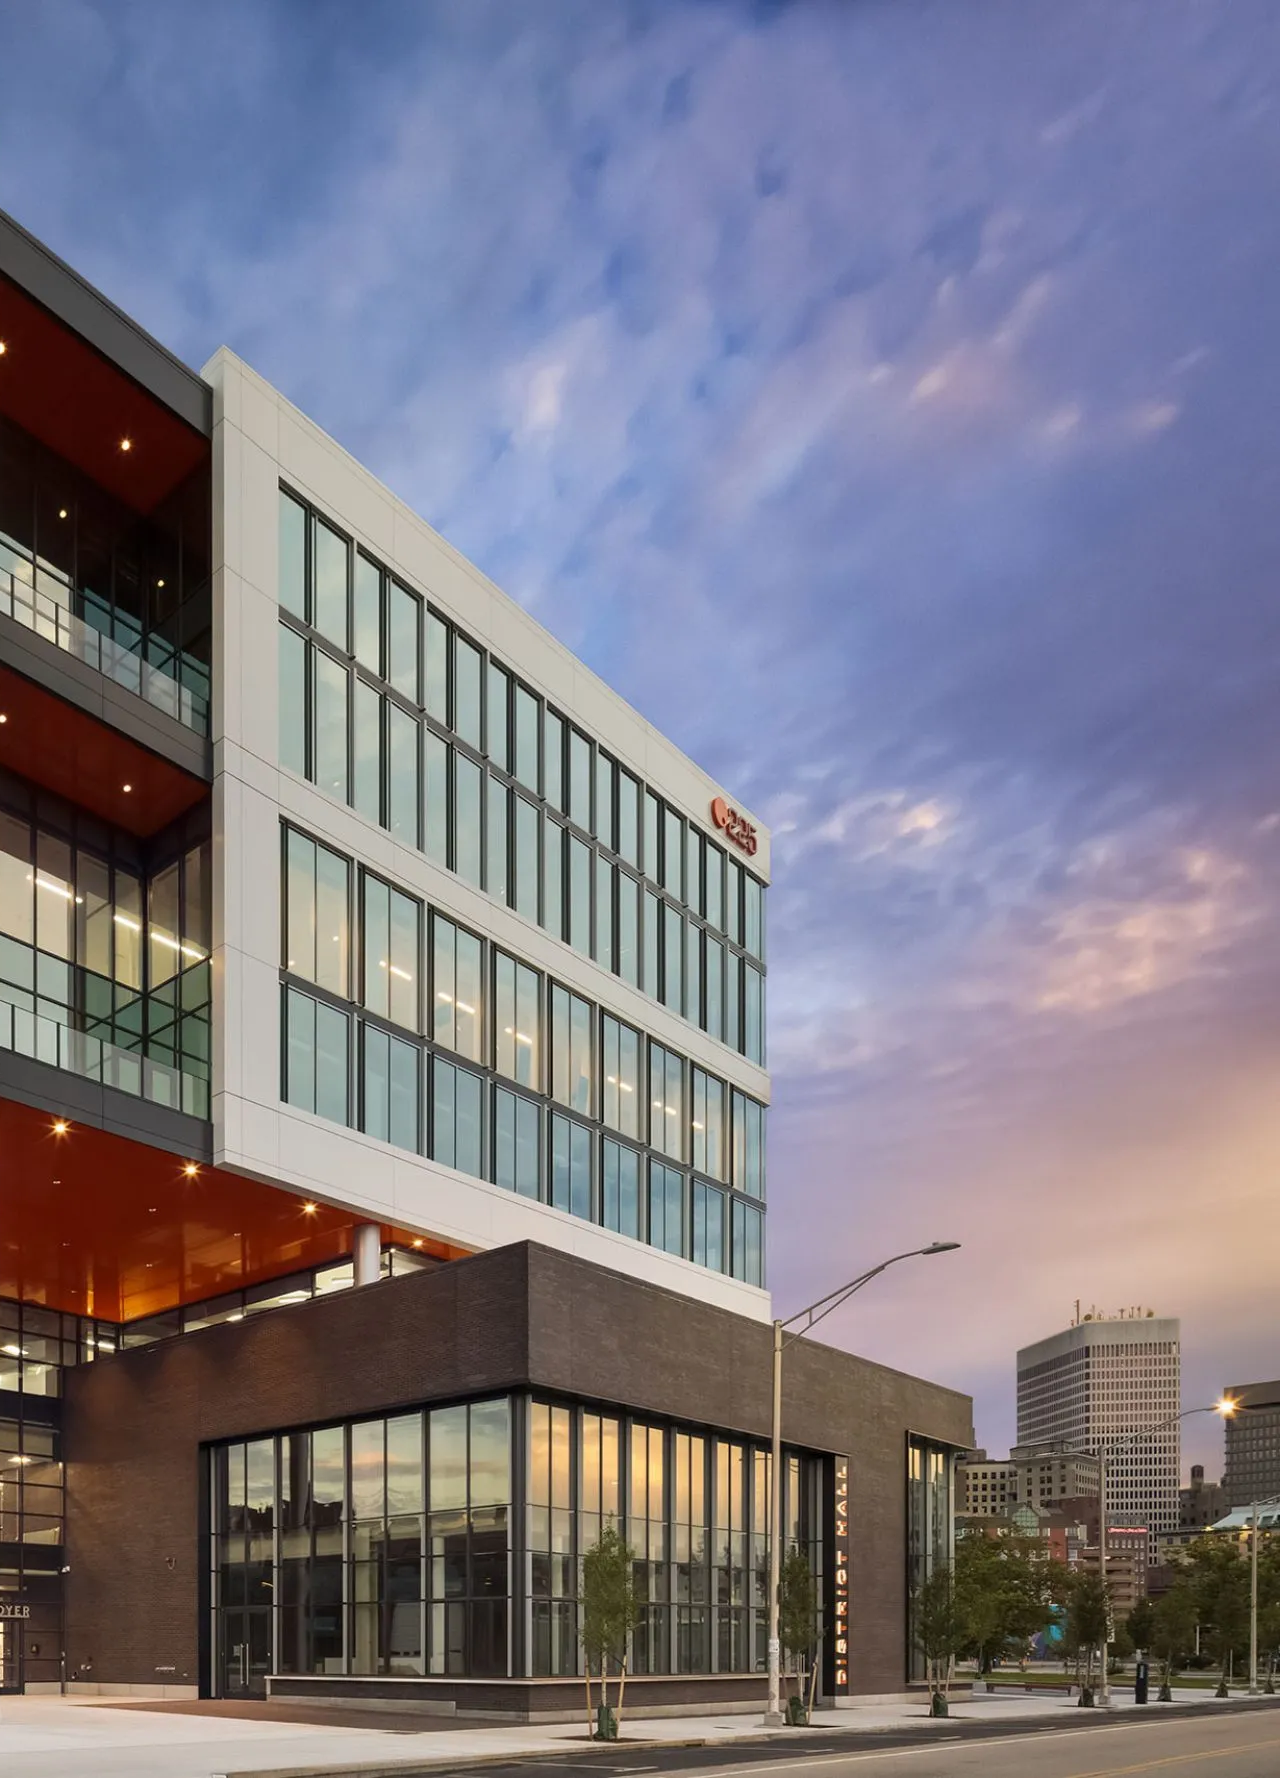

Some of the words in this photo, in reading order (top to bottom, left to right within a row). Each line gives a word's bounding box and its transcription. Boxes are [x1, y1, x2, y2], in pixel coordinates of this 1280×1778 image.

[725, 808, 757, 857] 225
[836, 1466, 848, 1536] HALL
[836, 1550, 847, 1685] DISTRICT
